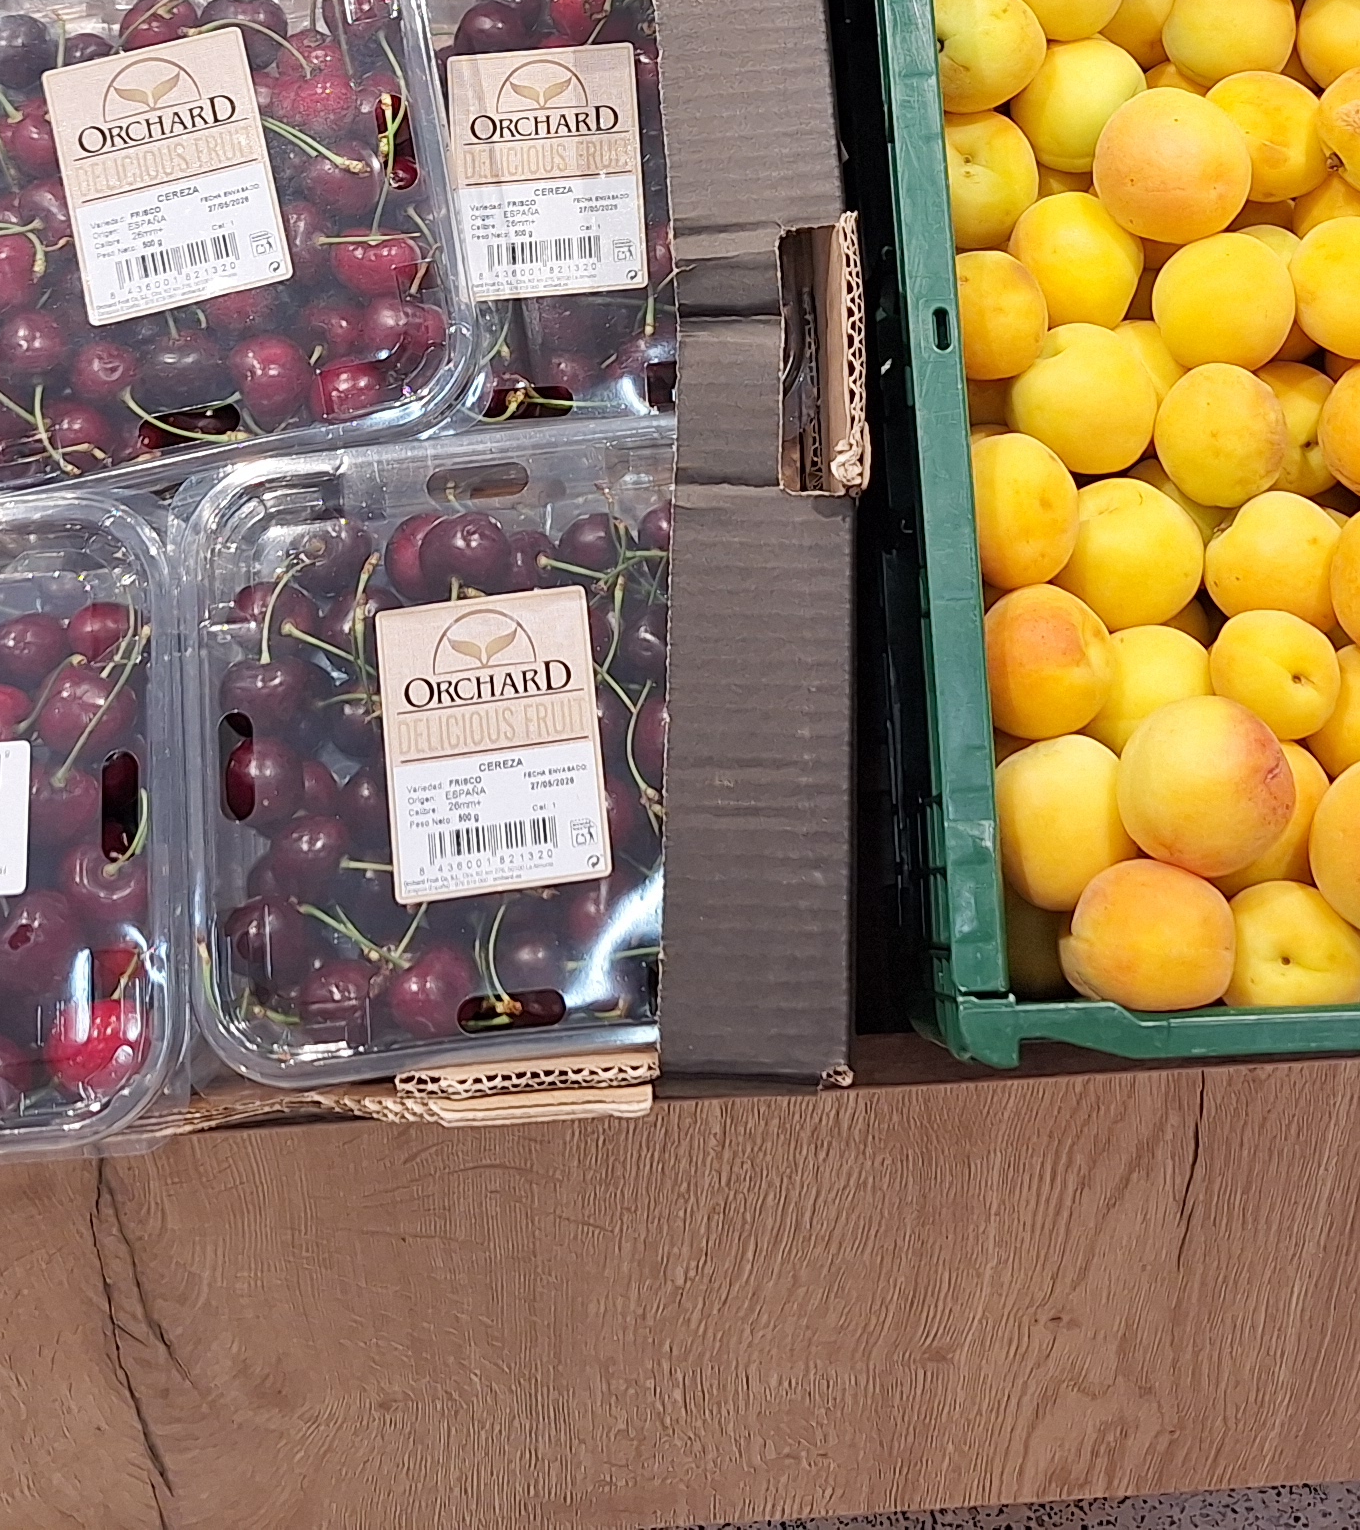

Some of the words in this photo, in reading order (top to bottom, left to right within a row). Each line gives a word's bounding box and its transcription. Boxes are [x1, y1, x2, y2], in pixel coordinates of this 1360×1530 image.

[75, 92, 238, 156] ORCHARD
[469, 104, 619, 141] ORCHARD
[156, 184, 199, 203] CEREZA
[534, 186, 573, 197] CEREZA
[403, 658, 572, 709] ORCHARD
[397, 705, 516, 756] DELICIOUS
[522, 695, 589, 738] FRUIT
[478, 757, 523, 772] CEREZA
[445, 784, 486, 799] ESPAÑA
